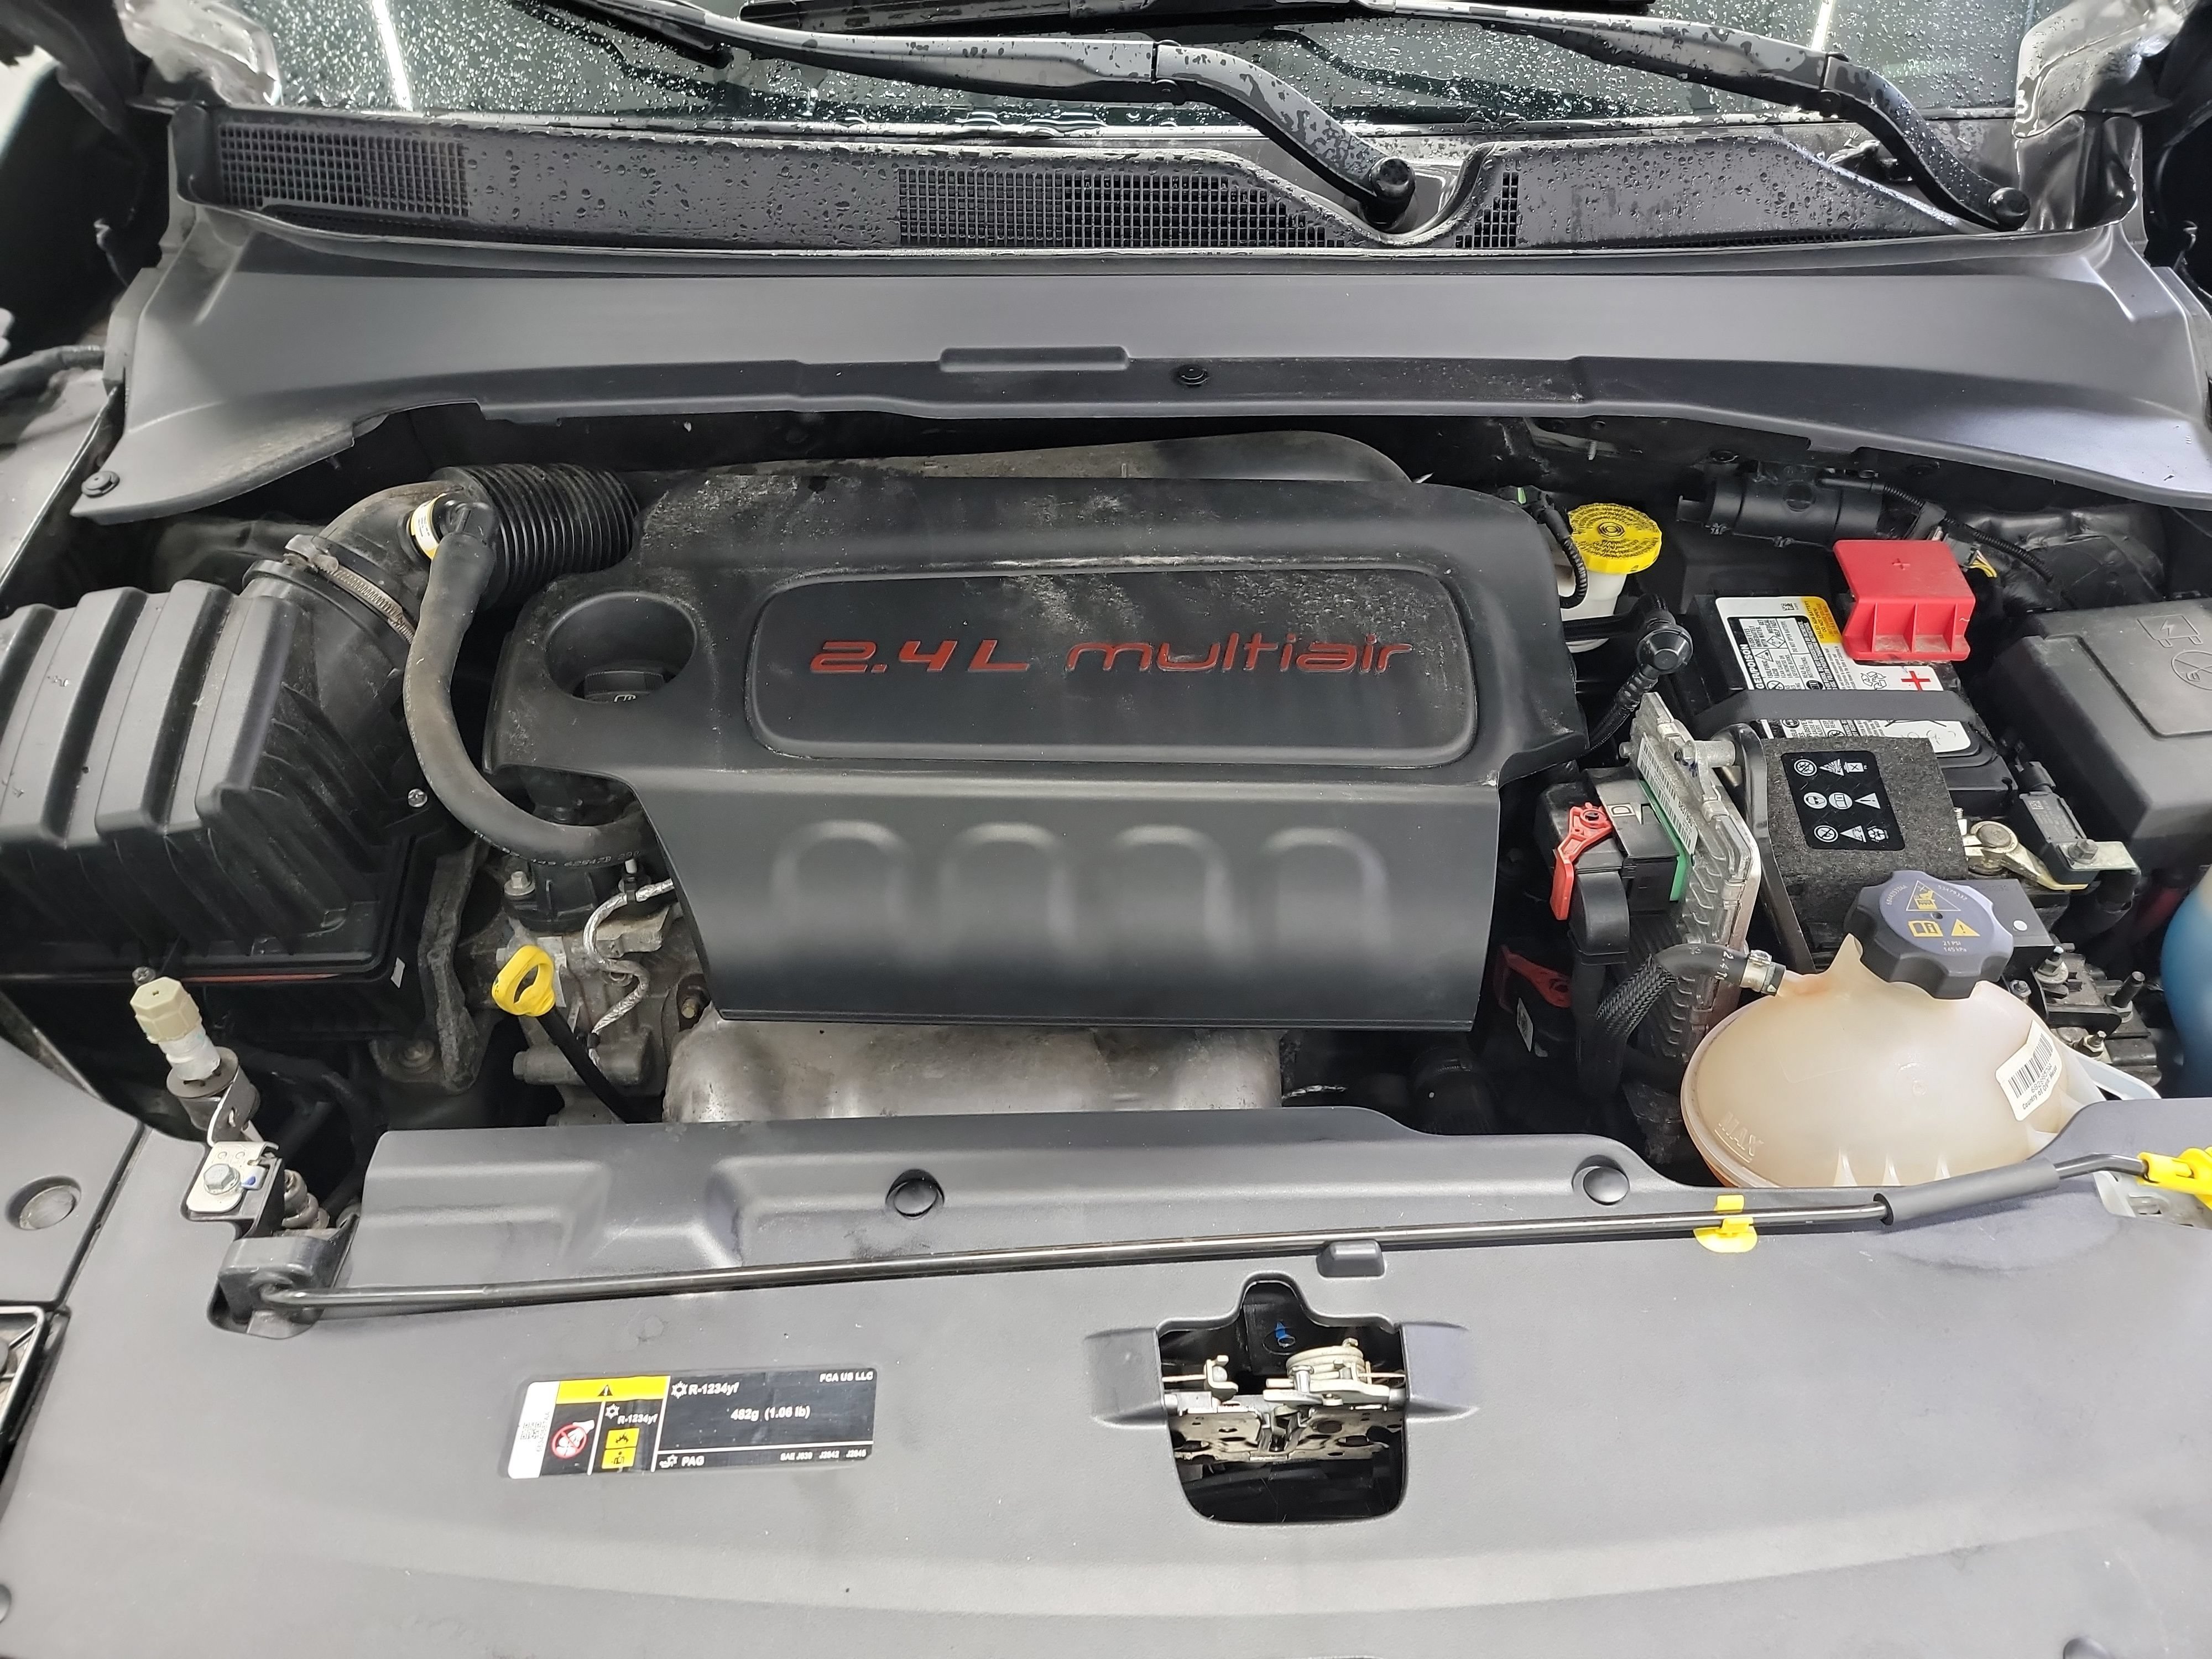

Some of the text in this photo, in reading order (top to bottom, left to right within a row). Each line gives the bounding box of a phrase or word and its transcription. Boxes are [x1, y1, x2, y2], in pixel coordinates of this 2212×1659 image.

[1066, 633, 1413, 674] multiair
[1739, 644, 1765, 688] GER/POISON
[2022, 1093, 2038, 1110] Country
[820, 1370, 874, 1383] FCA US LLC
[688, 1383, 740, 1396] R-1234yf
[794, 1405, 811, 1419] lb)
[617, 1413, 659, 1425] R-1234yf
[681, 1455, 705, 1467] PAG
